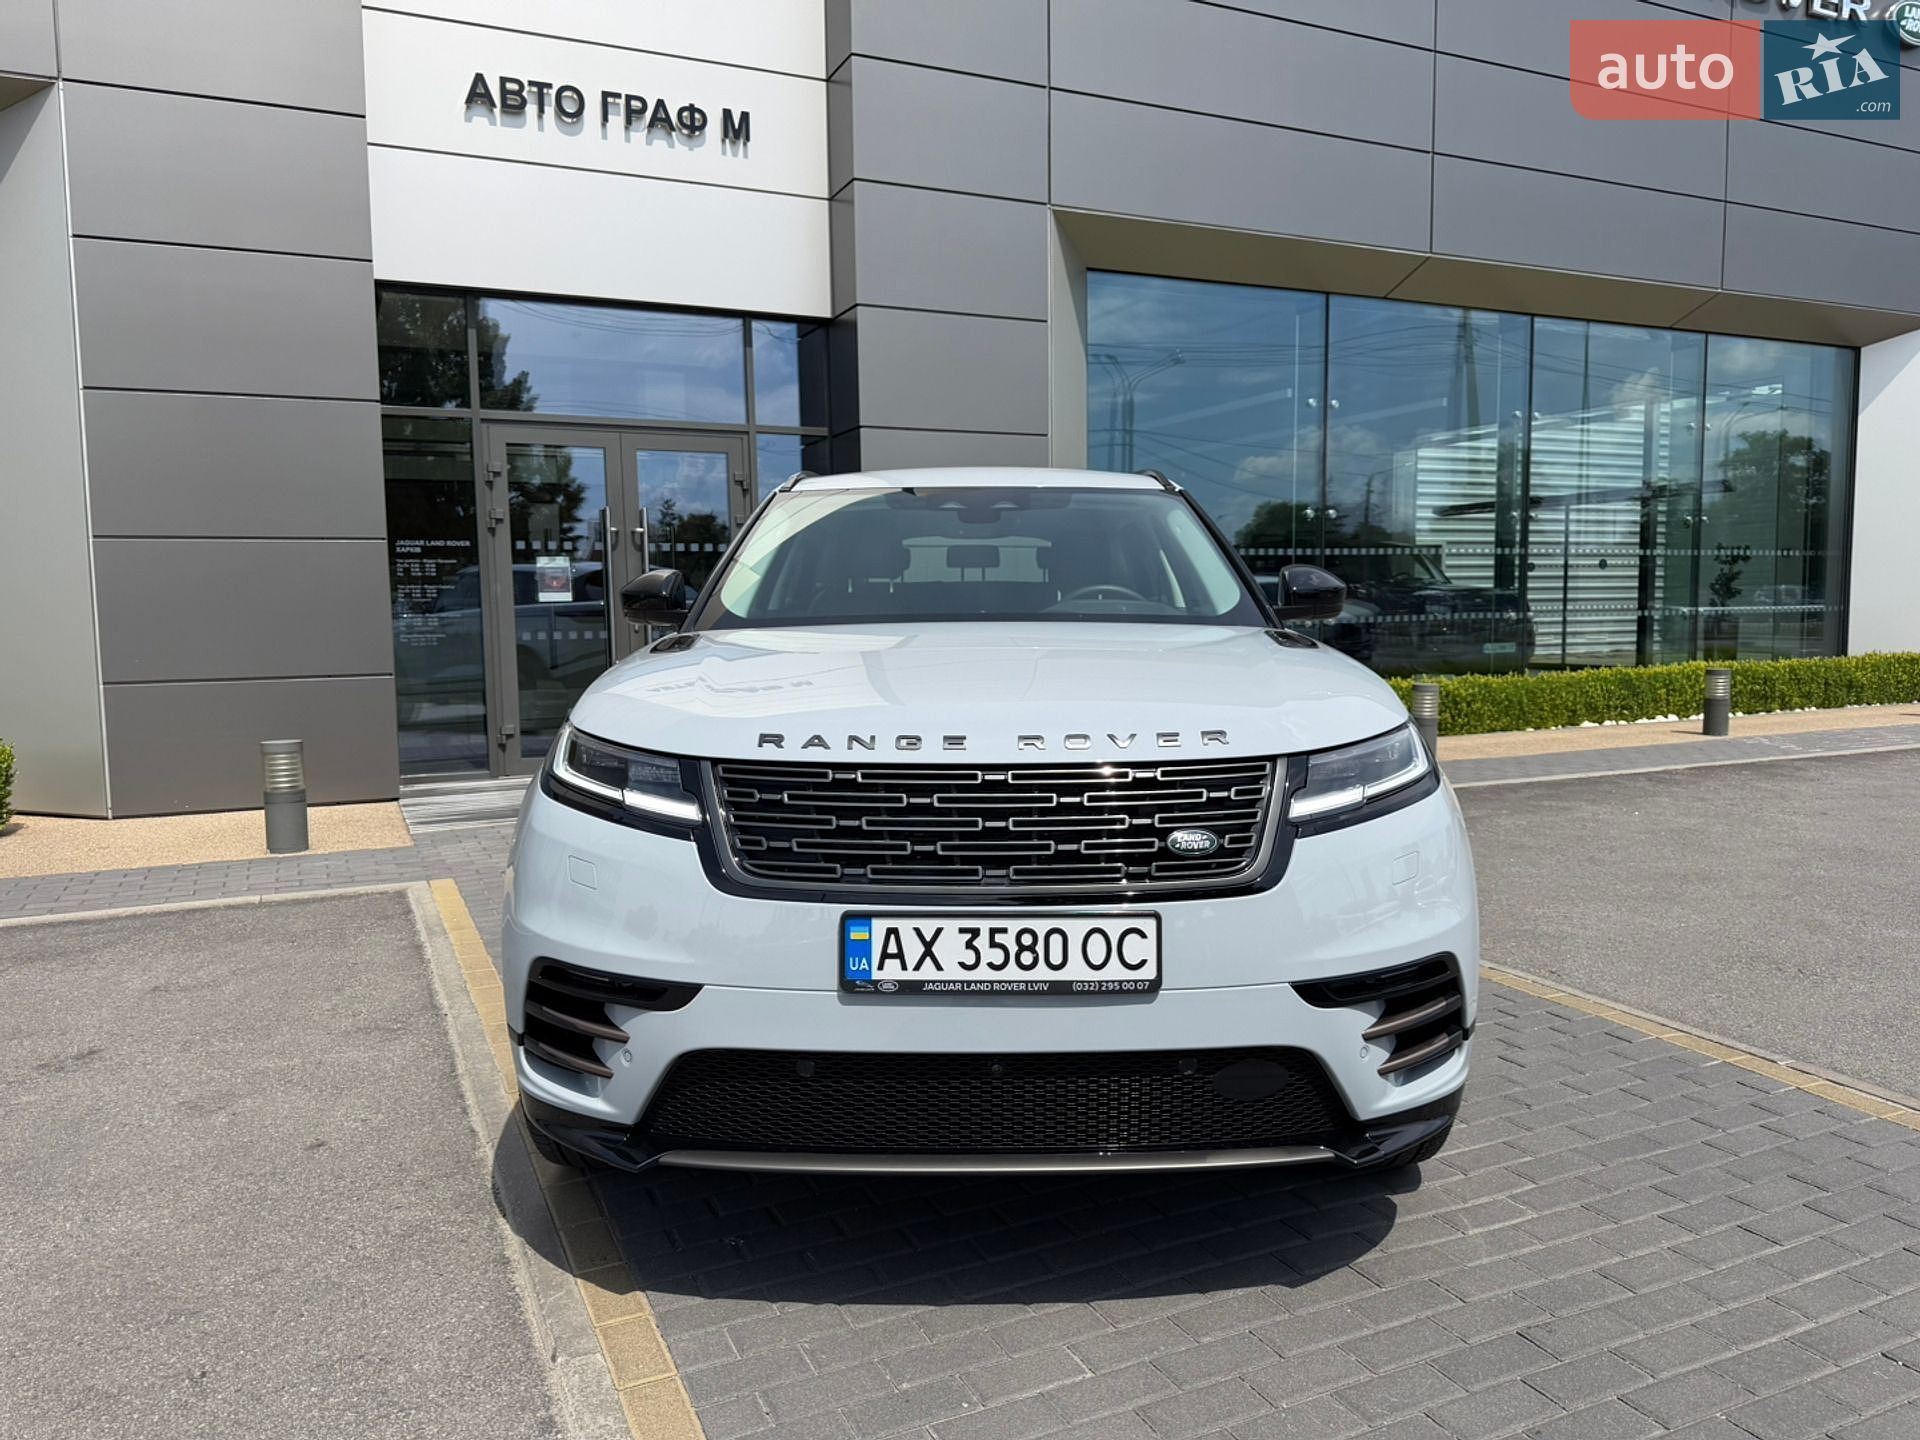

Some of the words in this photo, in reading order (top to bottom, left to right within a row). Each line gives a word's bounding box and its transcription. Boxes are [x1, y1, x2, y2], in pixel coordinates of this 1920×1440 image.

[464, 72, 586, 121] АВТО
[601, 90, 708, 135] ГРАФ
[722, 108, 750, 142] М
[757, 733, 967, 750] RANGE
[1017, 730, 1229, 750] ROVER
[1178, 833, 1202, 842] LAND
[1181, 840, 1211, 849] ROVER
[877, 927, 945, 971] AX
[957, 927, 1069, 971] 3580
[1081, 927, 1149, 971] OC
[849, 958, 869, 970] UA
[922, 982, 962, 991] JAGUAR
[964, 982, 991, 991] LAND
[993, 982, 1026, 991] ROVER
[1028, 982, 1050, 991] LVIV
[1072, 982, 1099, 991] (032)
[1101, 982, 1120, 990] 295
[1122, 982, 1136, 990] 00
[1137, 981, 1150, 990] 07
